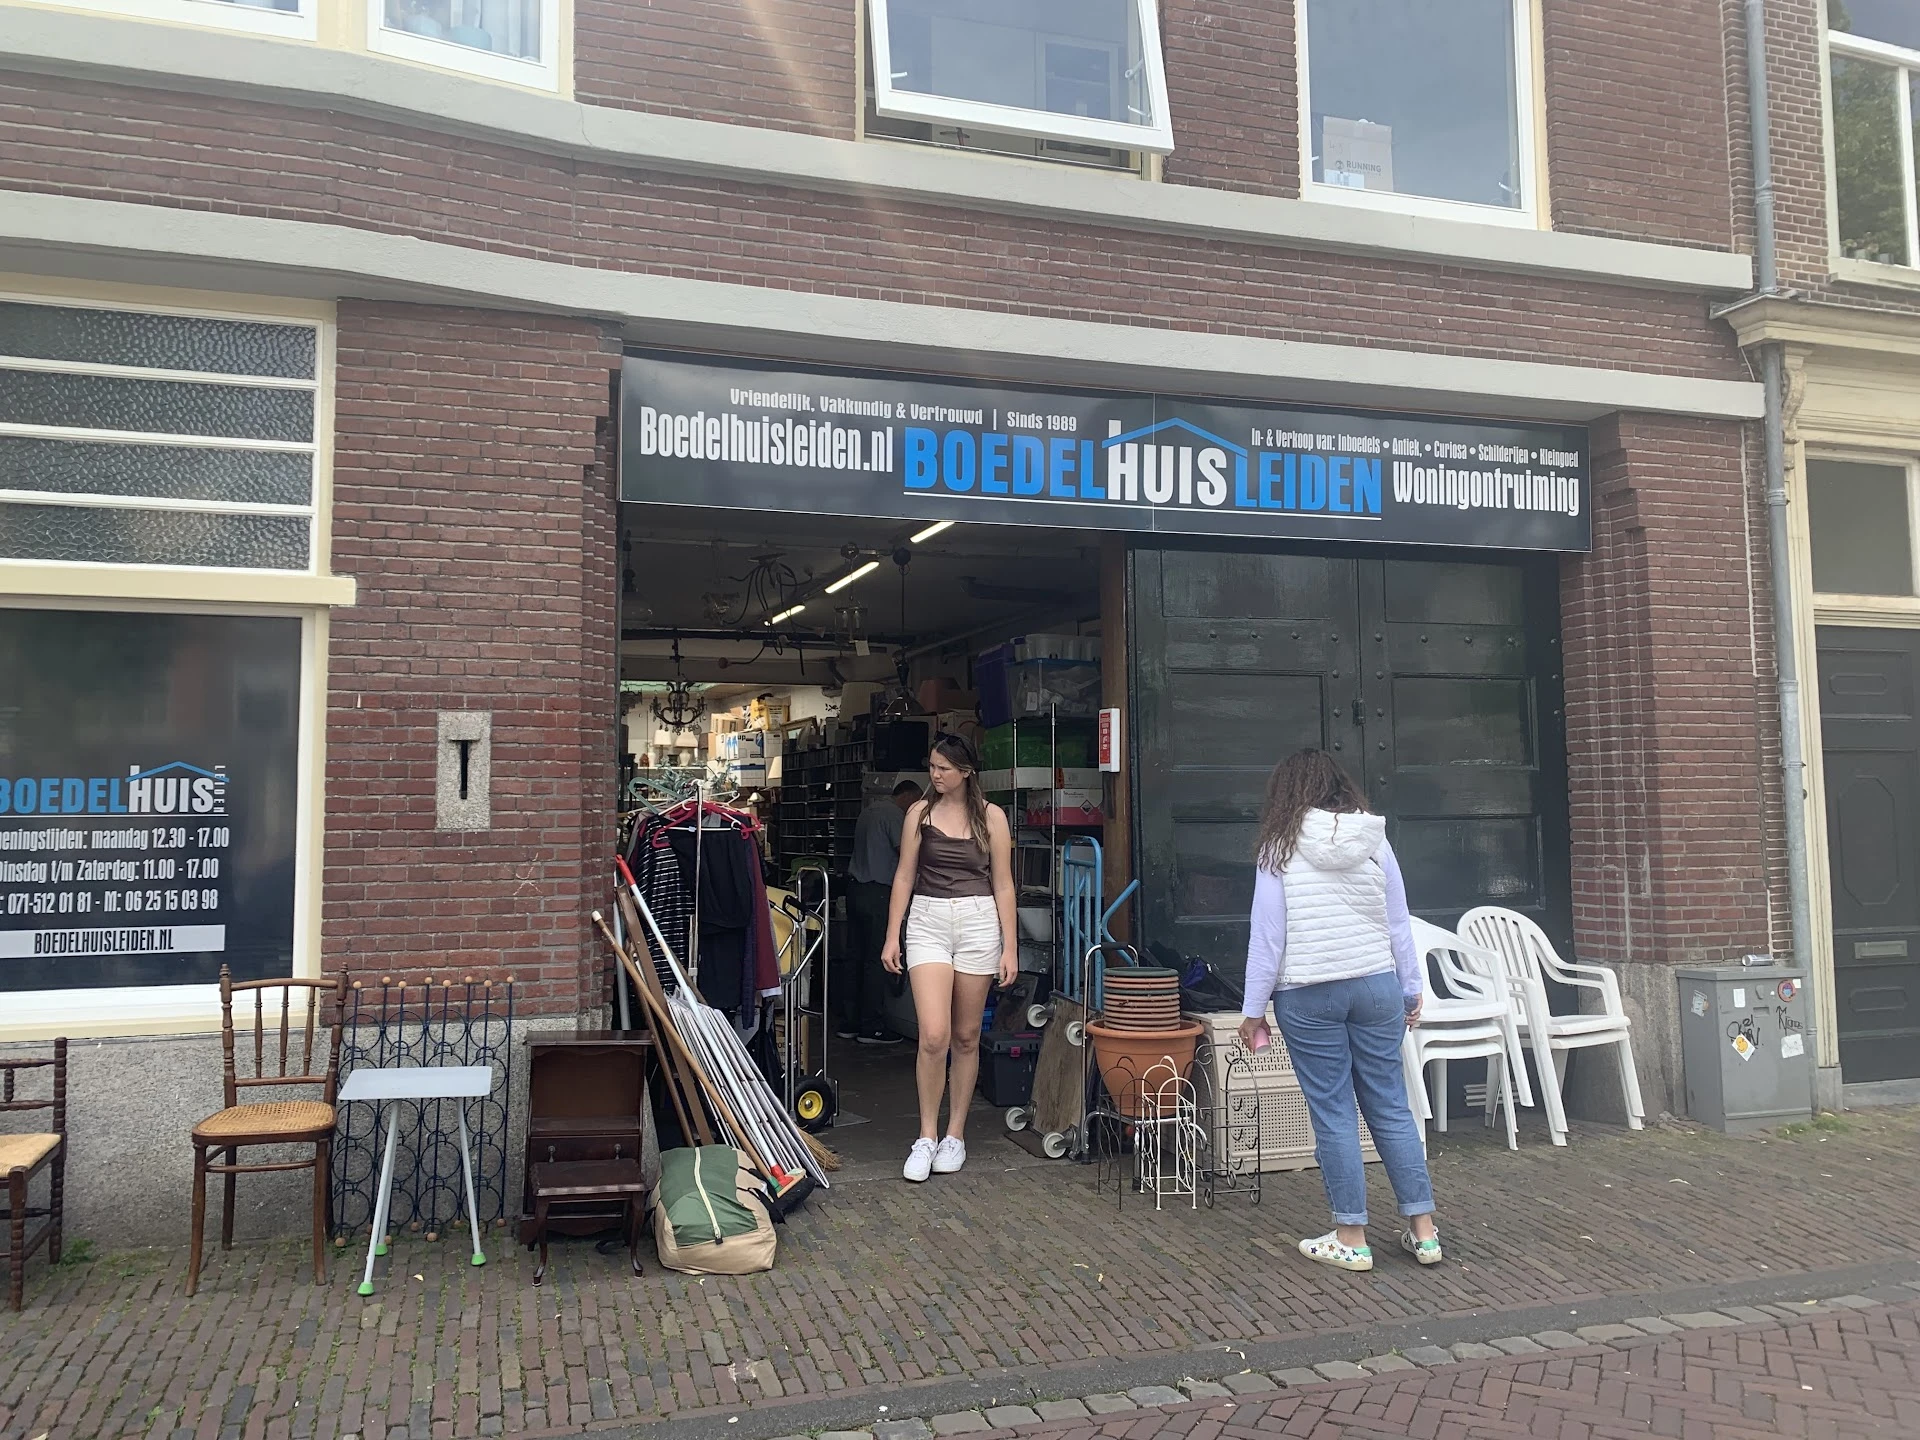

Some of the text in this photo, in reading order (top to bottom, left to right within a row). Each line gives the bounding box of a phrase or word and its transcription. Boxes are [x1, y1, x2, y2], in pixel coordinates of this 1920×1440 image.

[1347, 161, 1381, 172] RUNNING
[730, 388, 814, 412] Vriendelijk,
[820, 396, 892, 419] Vakkundig
[896, 402, 905, 418] &
[910, 403, 983, 425] Vertrouwd
[1007, 411, 1043, 429] Sinds
[1046, 414, 1076, 432] 1989
[641, 406, 893, 472] Boedelhuisleiden.nl
[1266, 429, 1273, 447] &
[1276, 430, 1313, 452] Verkoop
[1316, 433, 1335, 451] van:
[1338, 433, 1380, 454] Inboedels
[1392, 438, 1422, 457] Antiek,
[1434, 440, 1467, 460] Curiosa
[1478, 444, 1529, 464] Schilderijen
[1540, 447, 1579, 468] Kleingoed
[1393, 460, 1580, 516] Woningontruiming
[92, 828, 148, 850] maandag
[152, 828, 186, 848] 12.30
[198, 827, 229, 848] 17.00
[51, 860, 72, 884] t/m
[76, 859, 139, 882] Zaterdag:
[143, 858, 174, 880] 11.00
[187, 858, 219, 878] 17.00
[8, 892, 54, 914] 071-512
[59, 892, 72, 913] 01
[77, 891, 90, 913] 81
[104, 891, 121, 912] M:
[125, 890, 141, 912] 06
[146, 890, 160, 911] 25
[165, 890, 177, 910] 15
[181, 889, 198, 910] 03
[202, 889, 218, 910] 98
[34, 929, 174, 954] BOEDELHUISLEIDEN.NL
